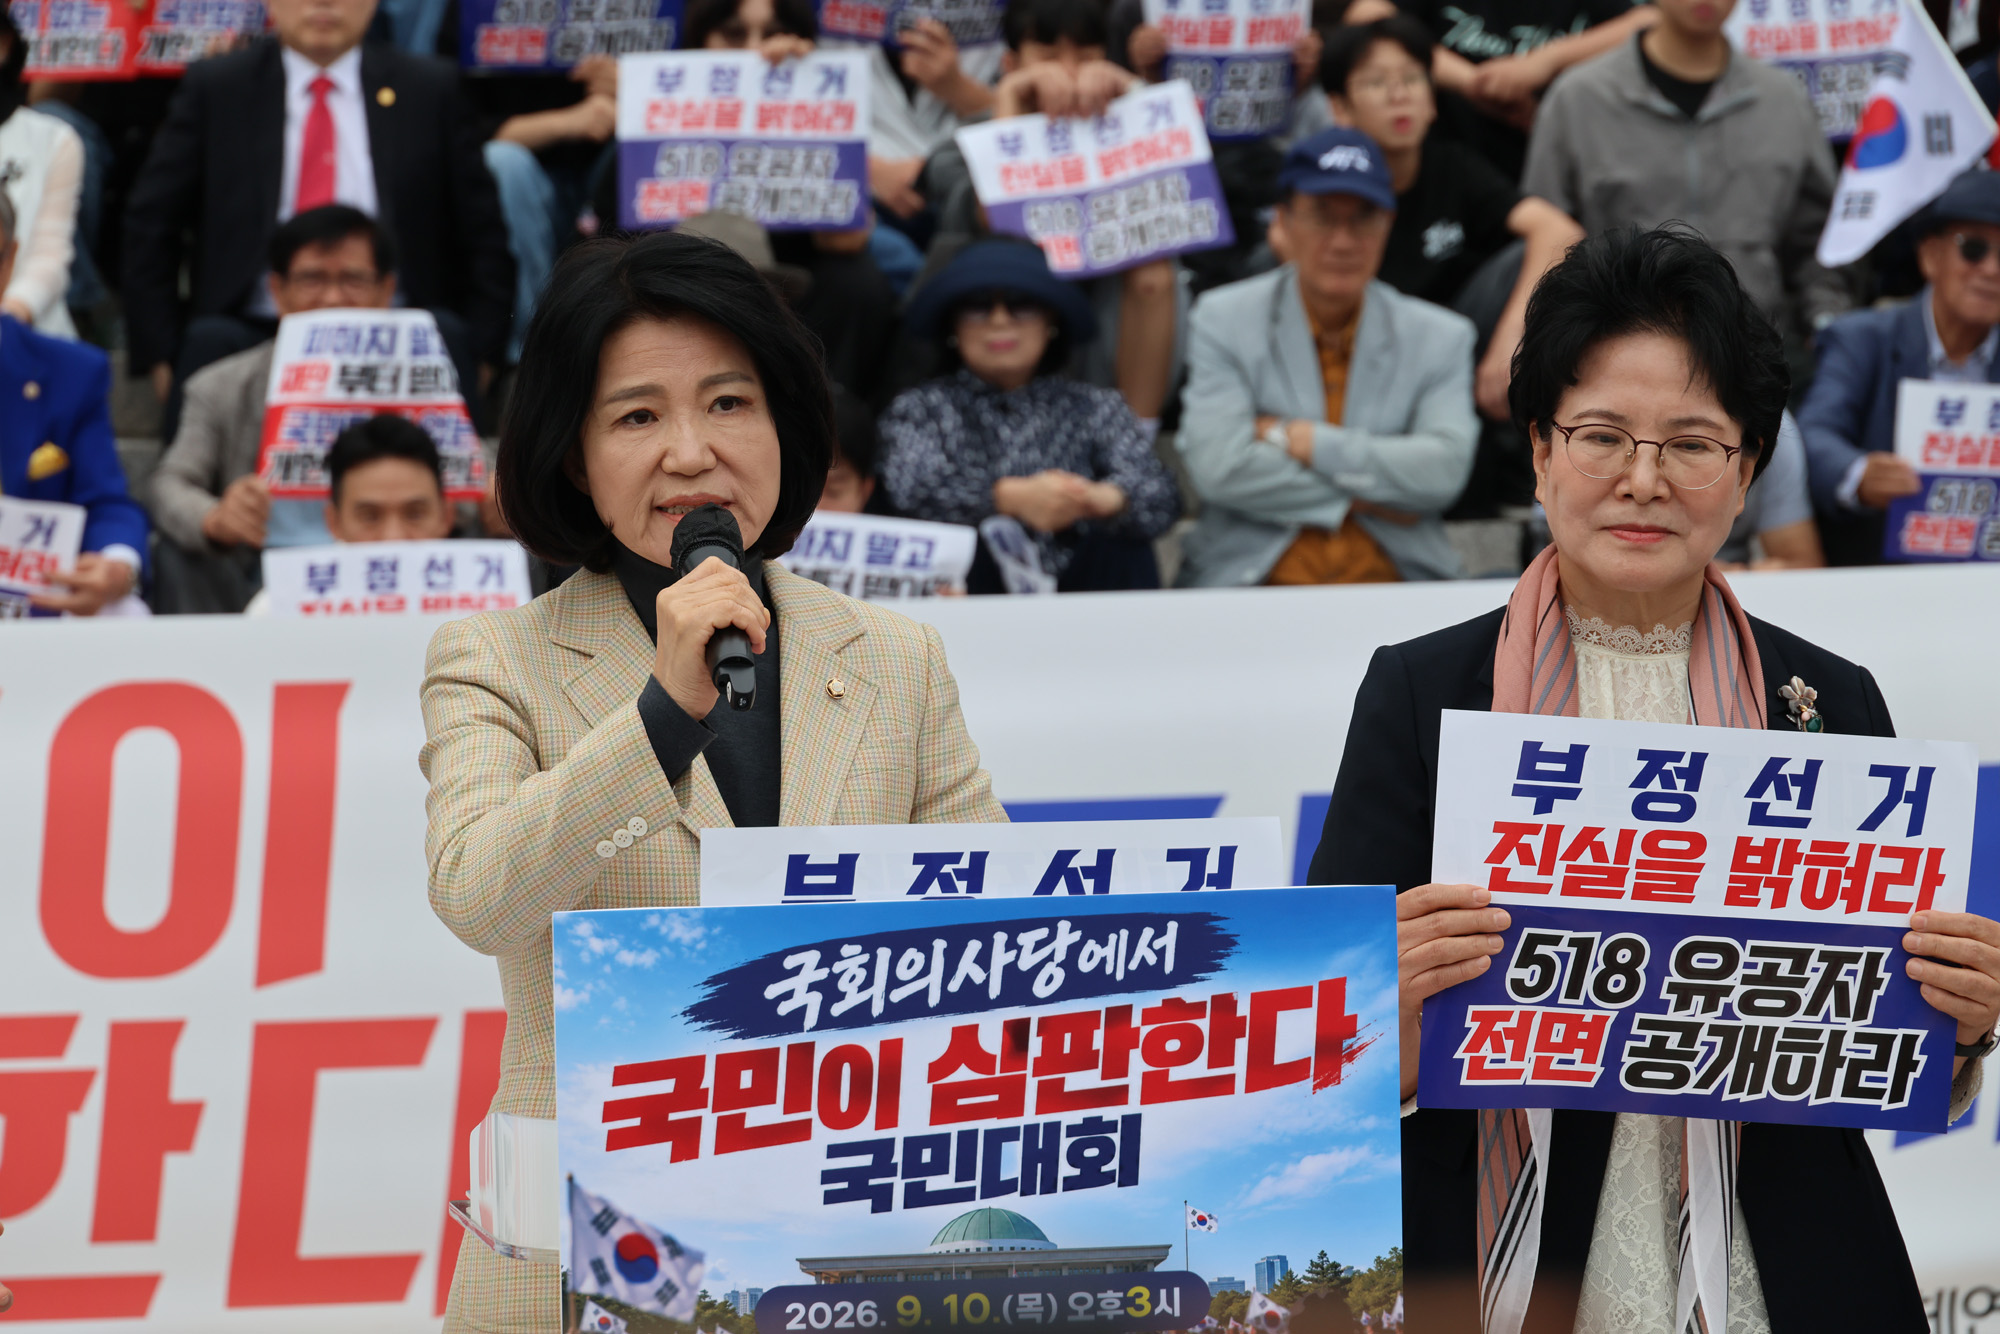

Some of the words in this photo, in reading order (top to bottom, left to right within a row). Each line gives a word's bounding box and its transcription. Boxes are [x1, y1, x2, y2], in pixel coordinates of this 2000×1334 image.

[657, 145, 724, 179] 518
[1484, 821, 1707, 904] 진실을
[1724, 836, 1946, 915] 밝혀라
[764, 920, 1178, 1032] 국회의사당에서
[1505, 927, 1650, 1008] 518
[1660, 935, 1892, 1026] 유공자
[602, 1037, 904, 1163] 국민이
[927, 976, 1364, 1125] 심판한다
[1454, 1004, 1619, 1087] 전면
[1619, 1013, 1928, 1111] 공개하라
[821, 1112, 1142, 1213] 국민대회
[785, 1300, 887, 1331] 2026.
[896, 1295, 931, 1326] 9.
[1067, 1286, 1181, 1322] 오후3시
